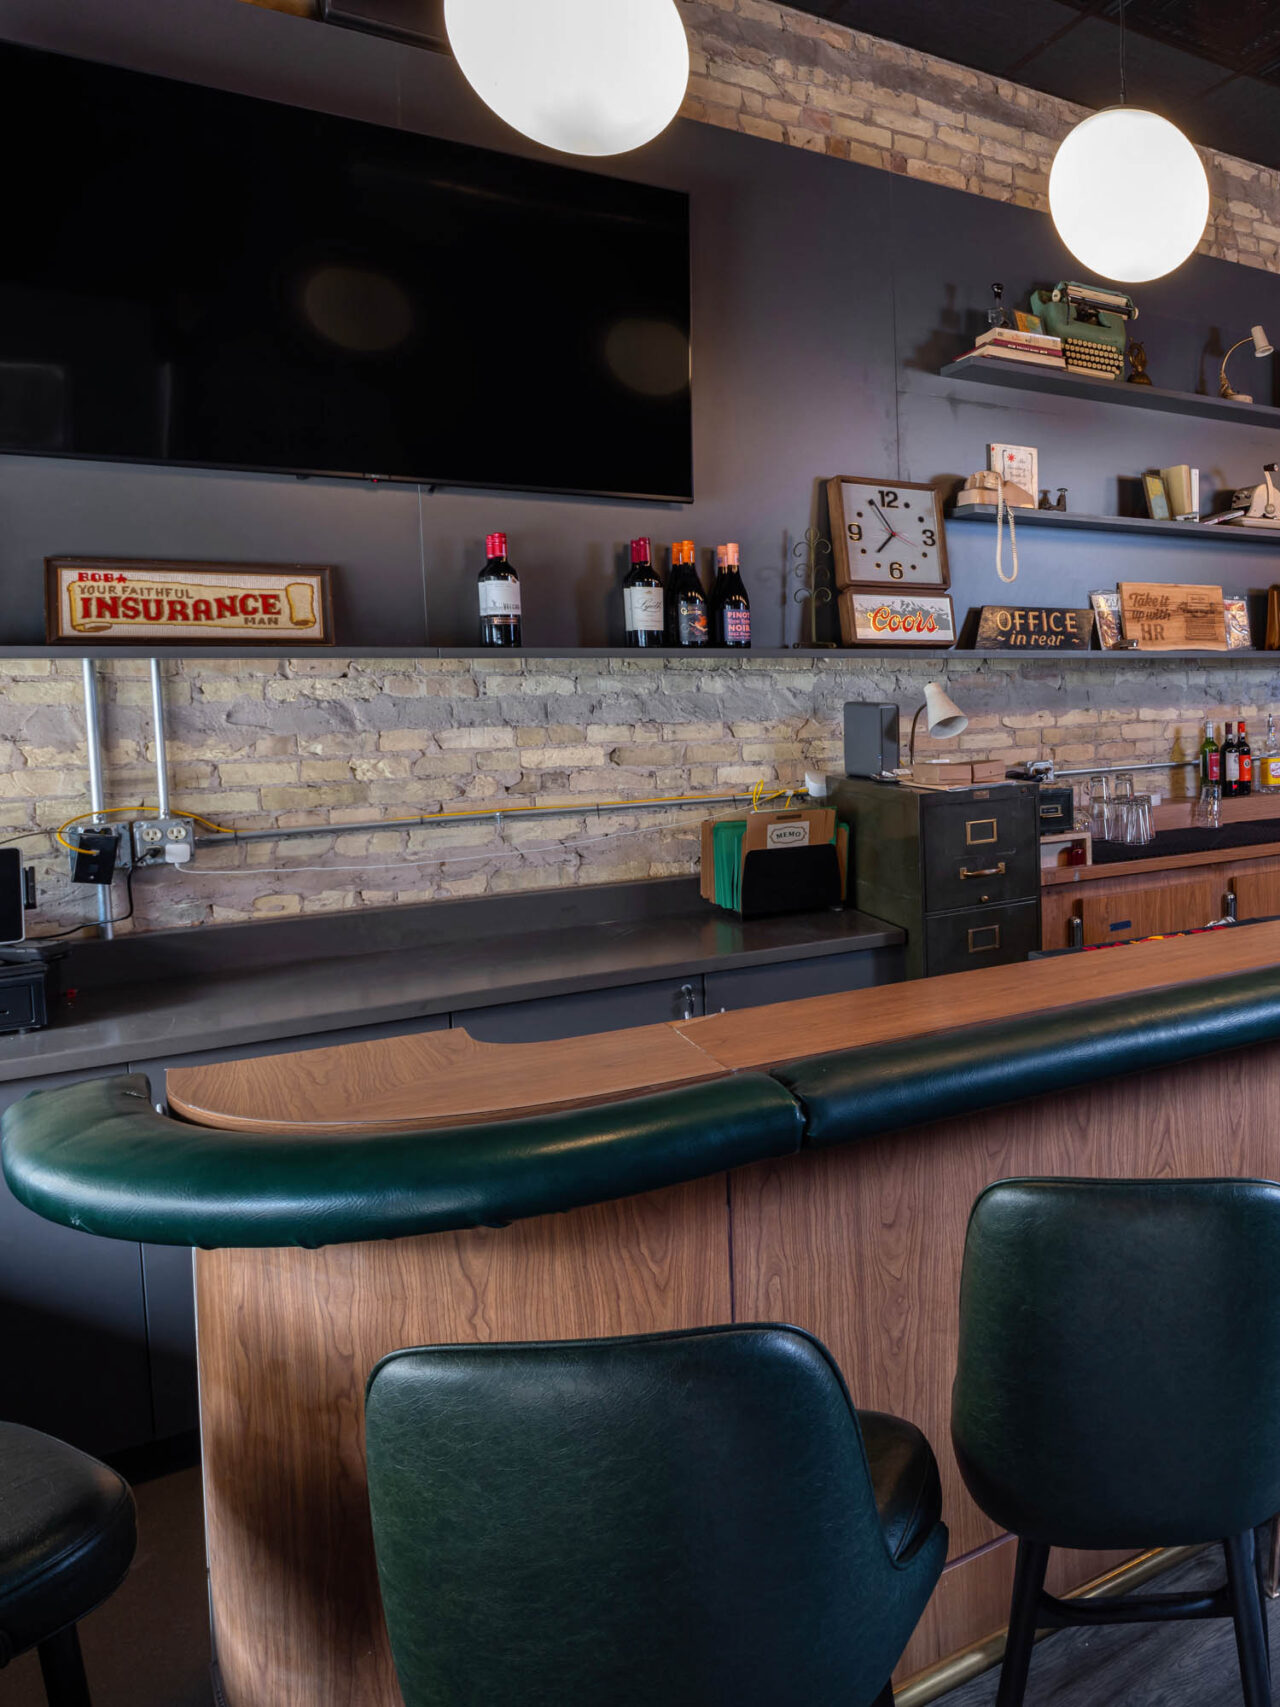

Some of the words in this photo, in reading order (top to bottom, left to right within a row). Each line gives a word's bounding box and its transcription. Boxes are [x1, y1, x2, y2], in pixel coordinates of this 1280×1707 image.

[878, 490, 899, 508] 12
[847, 522, 863, 542] 9
[921, 529, 936, 546] 3
[78, 572, 114, 583] BOB
[889, 562, 904, 580] 6
[78, 585, 118, 595] YOUR
[121, 586, 195, 599] FAITHFUL
[1129, 592, 1159, 608] Take
[80, 593, 282, 622] INSURANCE
[1132, 610, 1145, 622] up
[1146, 609, 1171, 621] with
[243, 617, 279, 625] MAN
[867, 606, 939, 633] Coors
[997, 610, 1078, 632] OFFICE
[1009, 630, 1026, 645] in
[1030, 634, 1064, 646] rear
[1141, 623, 1165, 641] HR
[776, 831, 802, 839] MEMO
